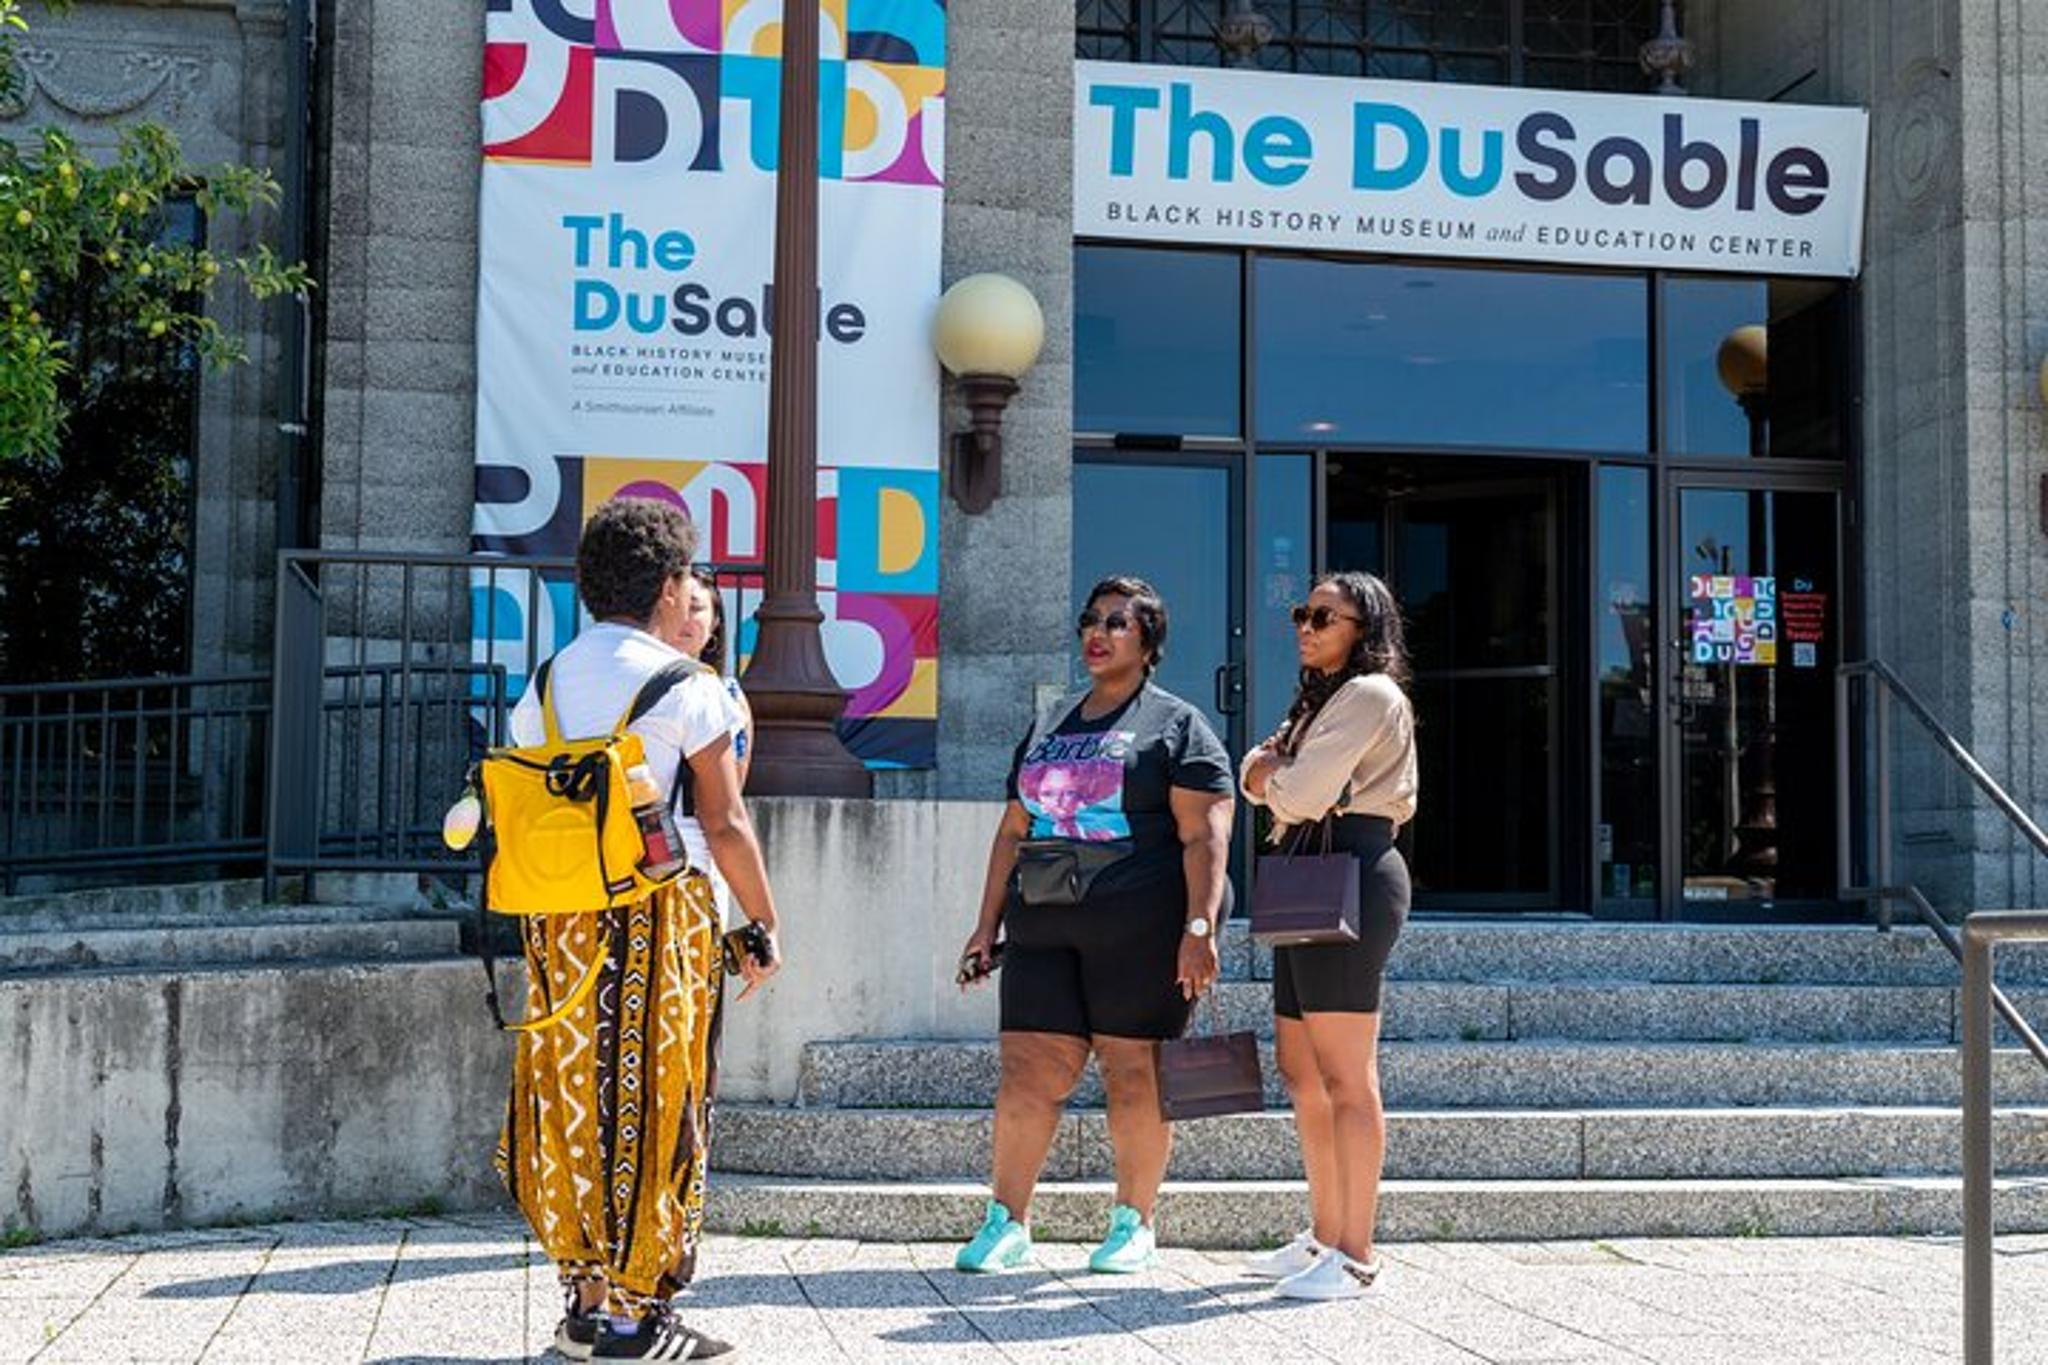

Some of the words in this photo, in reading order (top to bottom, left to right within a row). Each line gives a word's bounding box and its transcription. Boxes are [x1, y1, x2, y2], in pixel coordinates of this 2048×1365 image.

[1089, 82, 1312, 186] The
[1352, 101, 1830, 216] DuSable
[563, 213, 695, 271] The
[1107, 202, 1201, 225] BLACK
[1216, 209, 1341, 232] HISTORY
[1356, 217, 1475, 240] MUSEUM
[1485, 224, 1526, 243] and
[1537, 227, 1697, 251] EDUCATION
[1709, 235, 1814, 257] CENTER
[574, 280, 866, 344] DuSae
[572, 346, 627, 356] BLACK
[637, 348, 711, 360] HISTORY
[722, 351, 766, 365] MUSE
[572, 364, 598, 375] and
[603, 364, 704, 379] EDUCATION
[712, 369, 766, 382] CENTE
